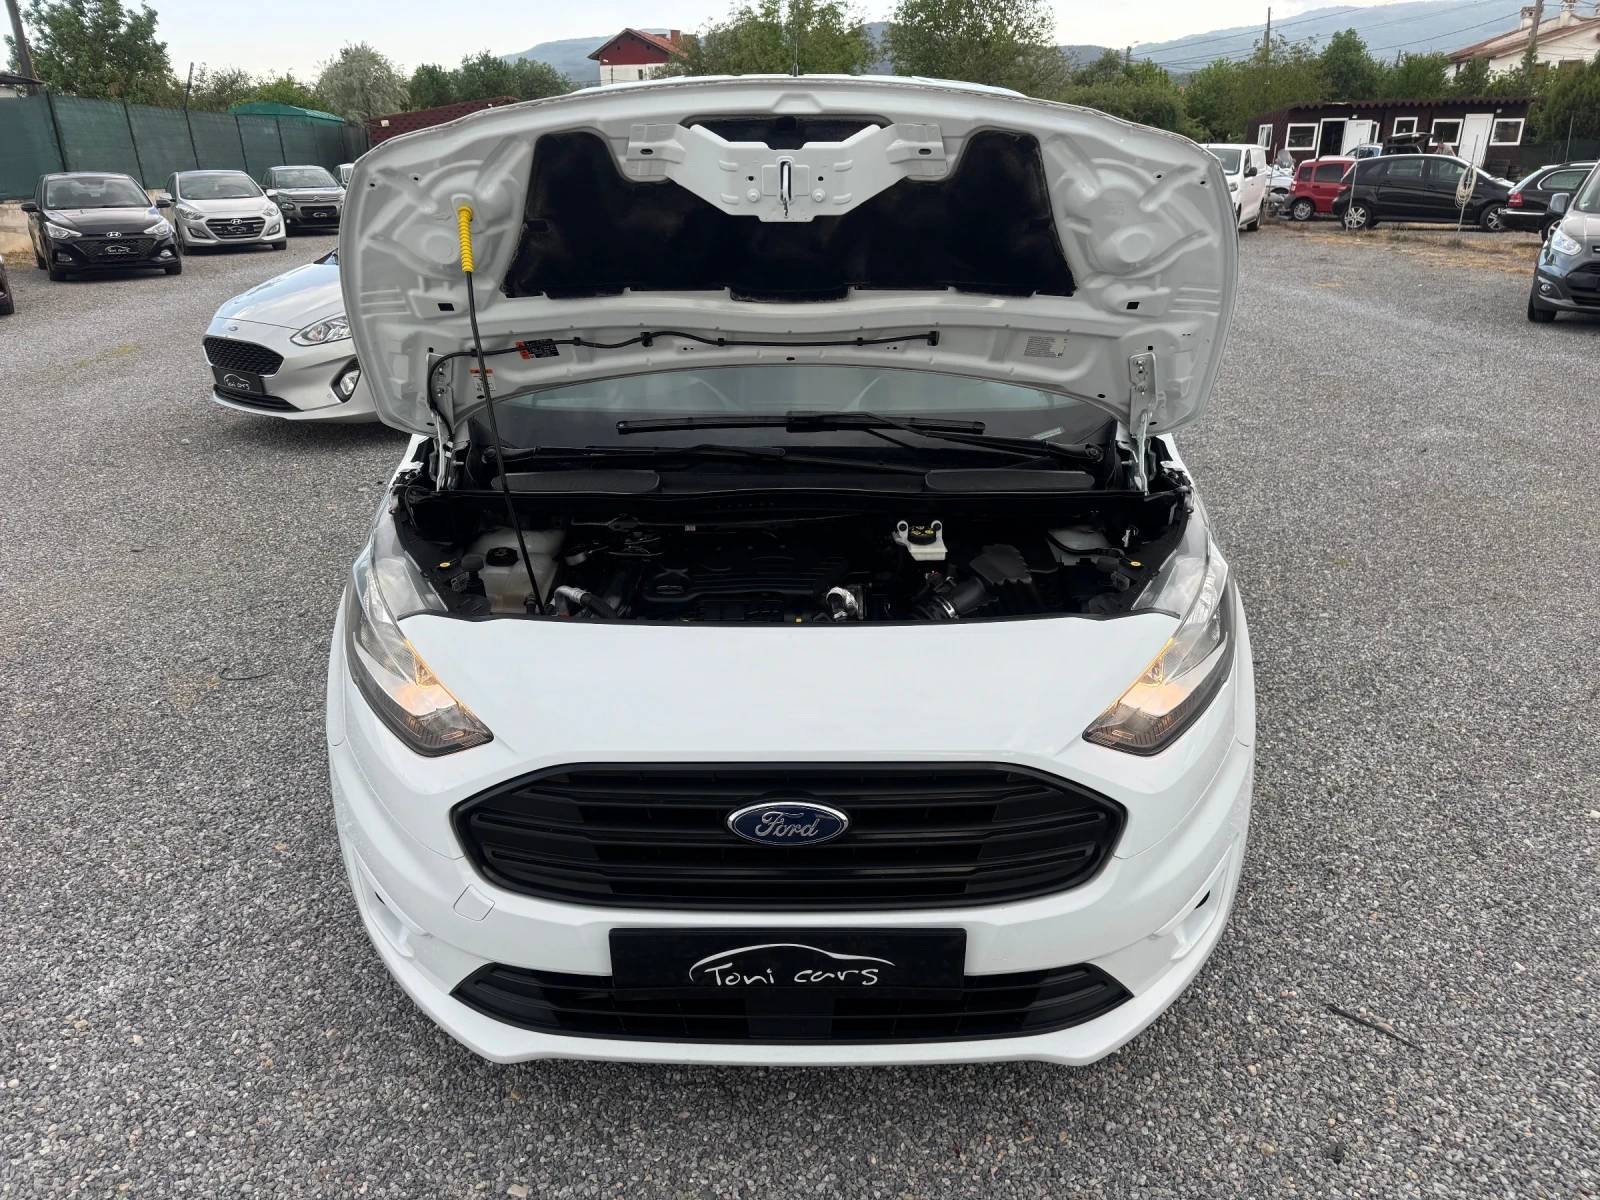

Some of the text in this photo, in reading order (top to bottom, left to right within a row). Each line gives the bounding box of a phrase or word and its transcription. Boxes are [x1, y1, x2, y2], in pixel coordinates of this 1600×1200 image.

[755, 811, 820, 837] Ford
[704, 961, 879, 987] Toni cars
